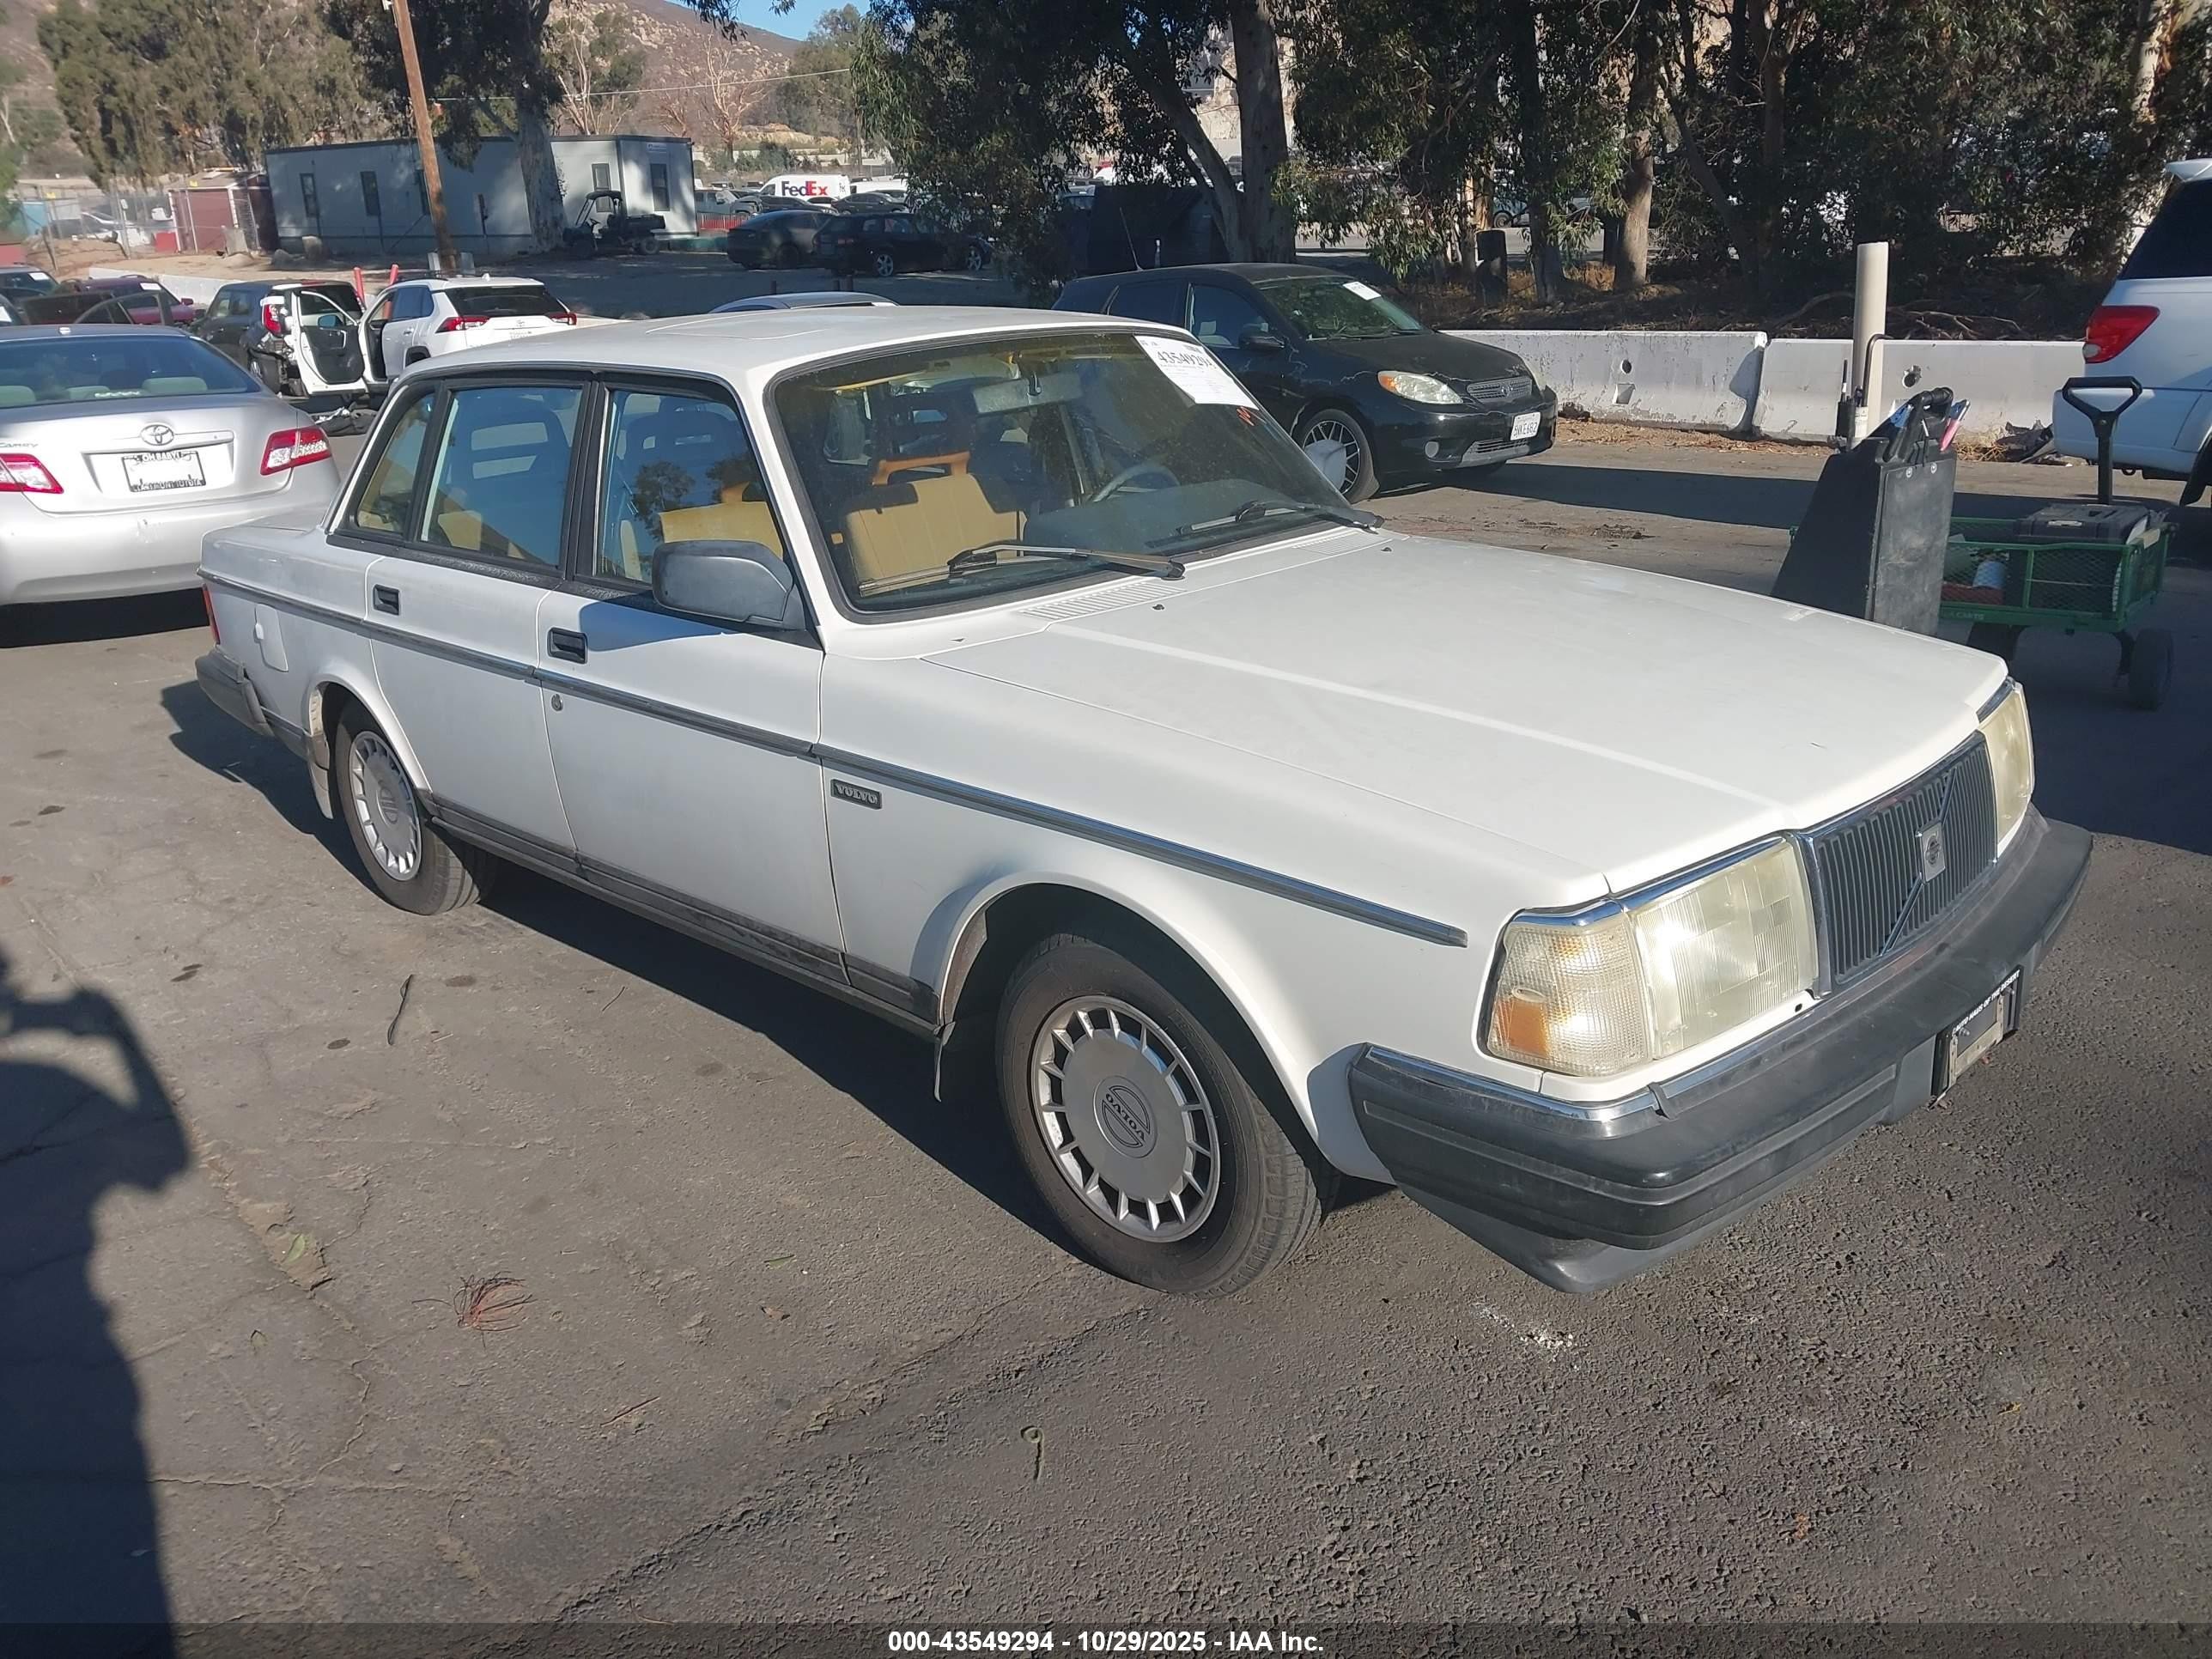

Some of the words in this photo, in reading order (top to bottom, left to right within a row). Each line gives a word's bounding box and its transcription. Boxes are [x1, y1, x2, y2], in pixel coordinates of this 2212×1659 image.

[781, 180, 828, 196] FedEx
[836, 782, 878, 804] VOLVO
[1105, 1092, 1146, 1142] VOLVO
